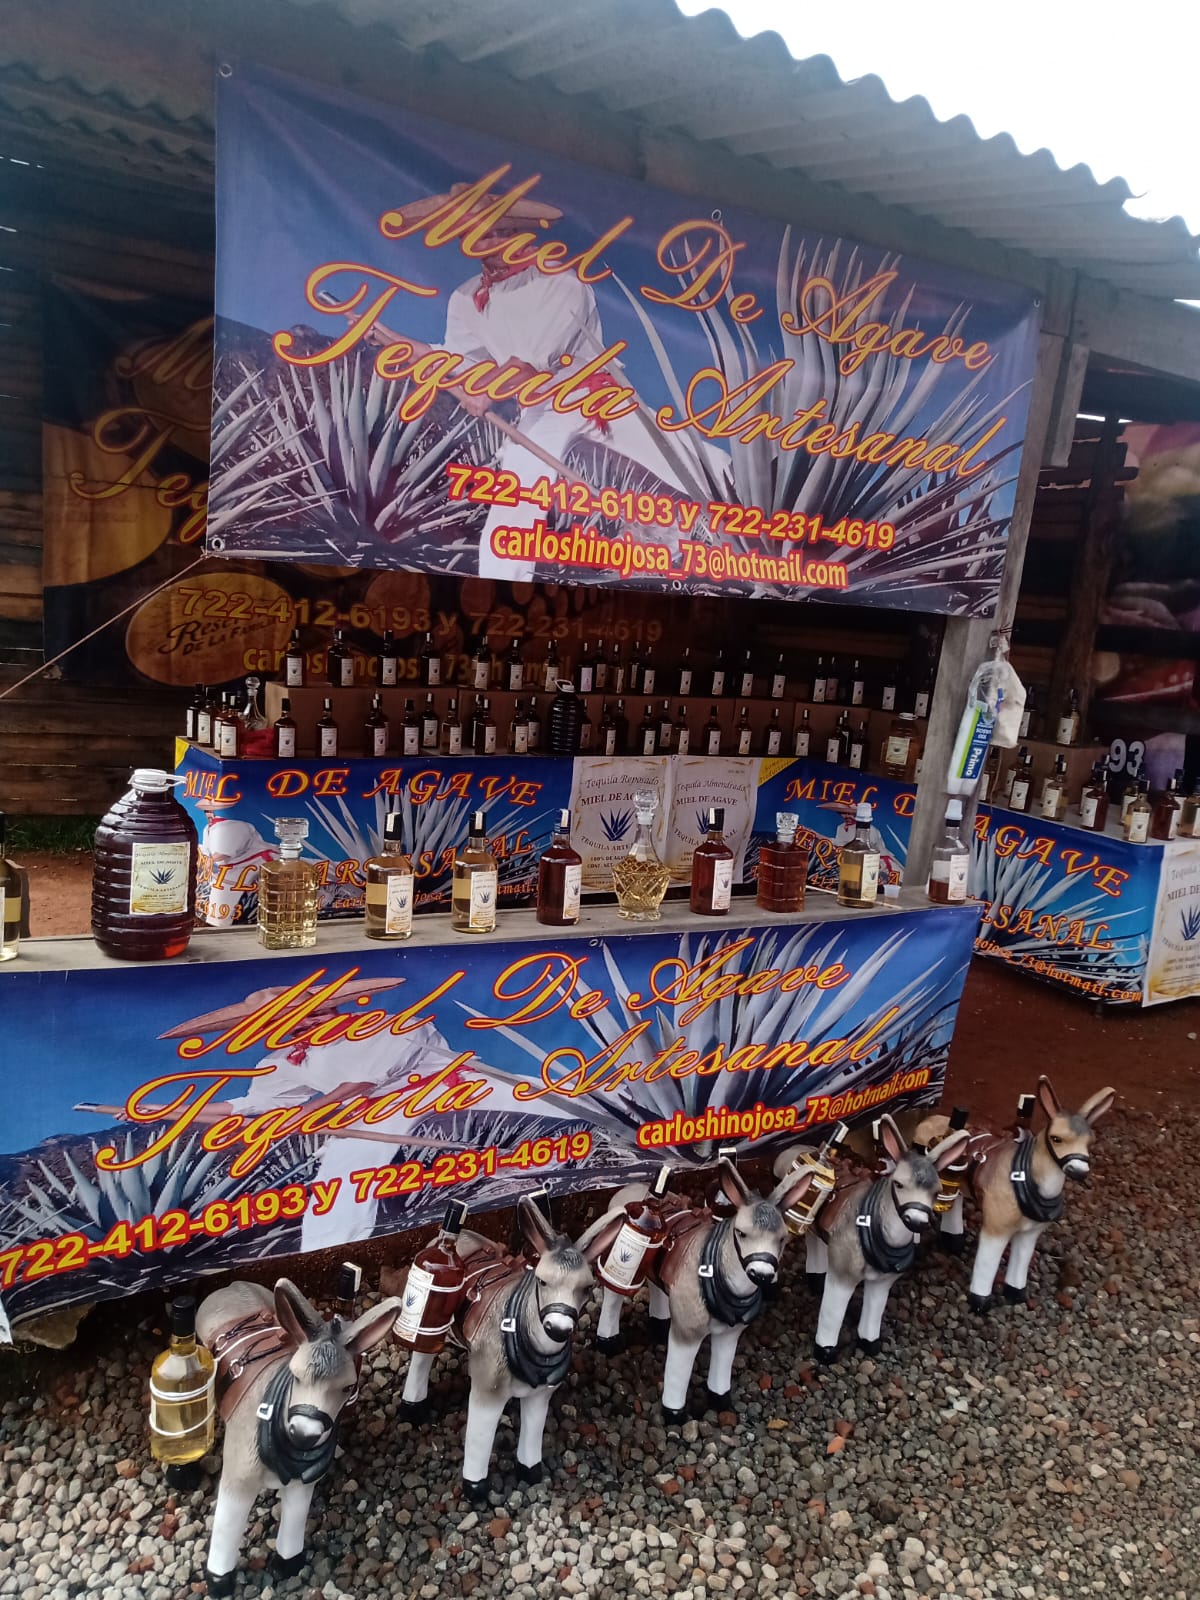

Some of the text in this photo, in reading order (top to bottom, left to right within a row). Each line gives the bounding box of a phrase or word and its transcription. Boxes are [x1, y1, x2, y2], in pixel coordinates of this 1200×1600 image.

[379, 163, 996, 376] Miel De Agave
[272, 261, 639, 422] Tequila
[656, 358, 1006, 478] Artesanal
[447, 464, 897, 551] 722-412-6193 y 722-231-4619
[178, 587, 432, 632] 722-412-6193
[184, 767, 544, 807] MIEL DE AGAVE
[783, 777, 879, 810] MIEL
[966, 747, 983, 777] Primo
[176, 936, 852, 1059] Miel De Agave
[95, 1005, 901, 1179] Tequila Artesanal
[0, 1130, 592, 1289] 722-412-6193 y 722-231-4619
